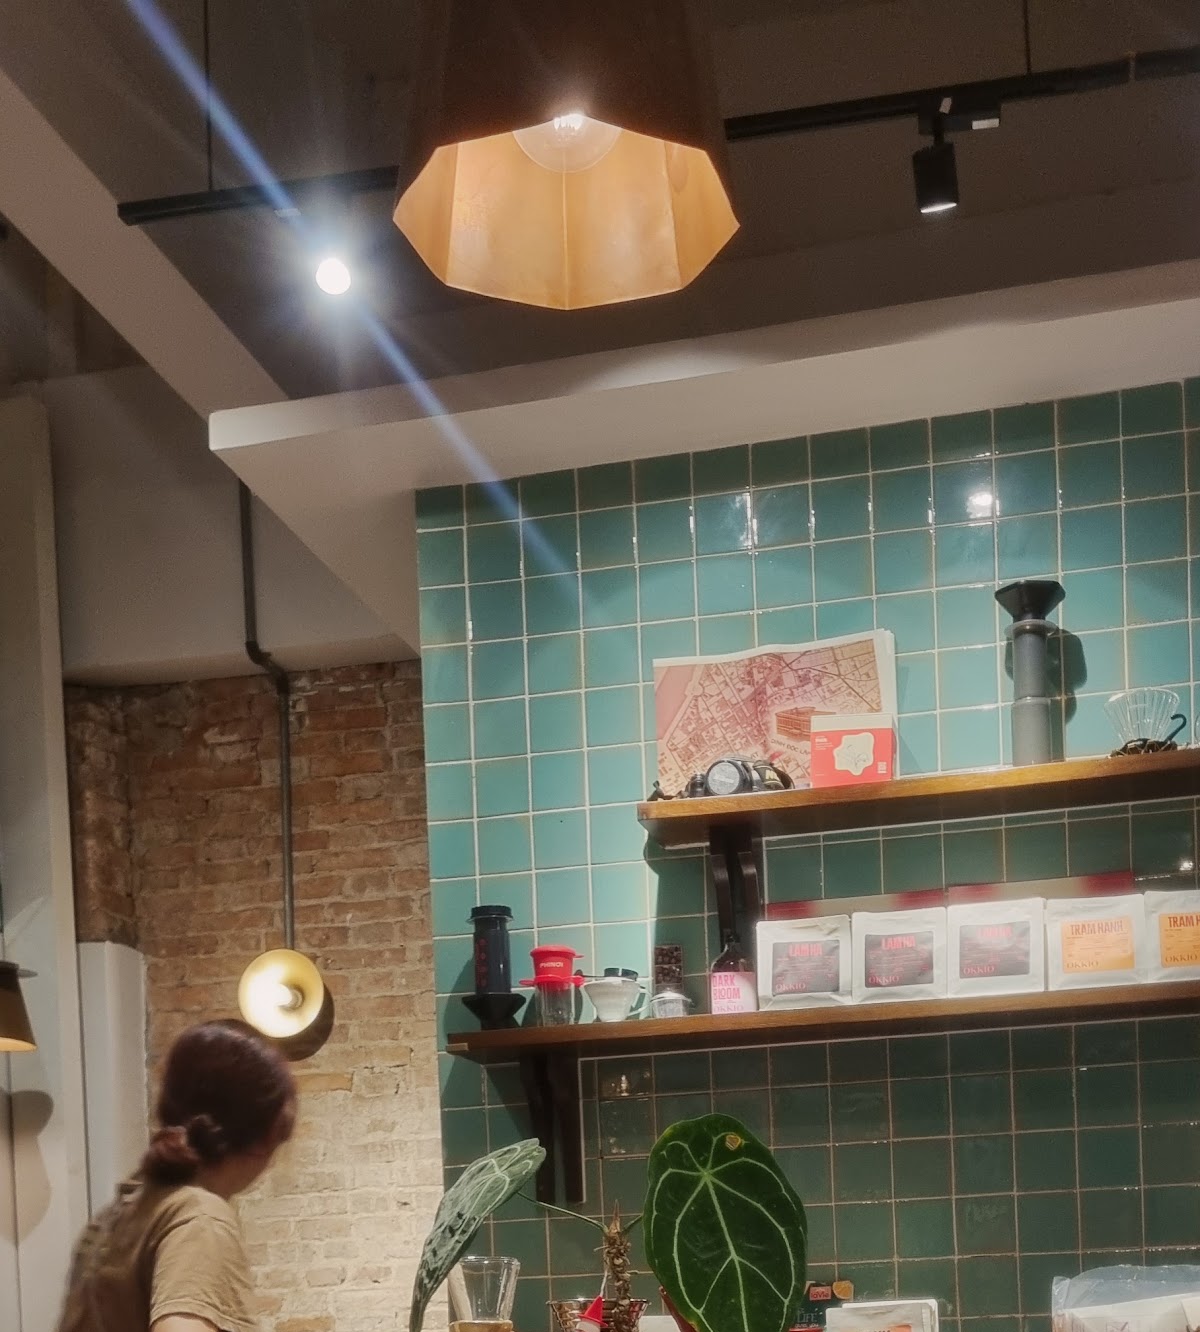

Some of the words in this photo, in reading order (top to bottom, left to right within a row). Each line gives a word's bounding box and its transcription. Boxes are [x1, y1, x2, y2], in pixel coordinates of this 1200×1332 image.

[1070, 922, 1096, 936] TRAM
[1097, 919, 1124, 934] HANH
[1168, 915, 1194, 928] TRAM
[1165, 953, 1198, 962] OKKIO
[963, 965, 995, 976] OKKIO
[1066, 960, 1099, 969] OKKIO
[712, 974, 736, 987] DARK
